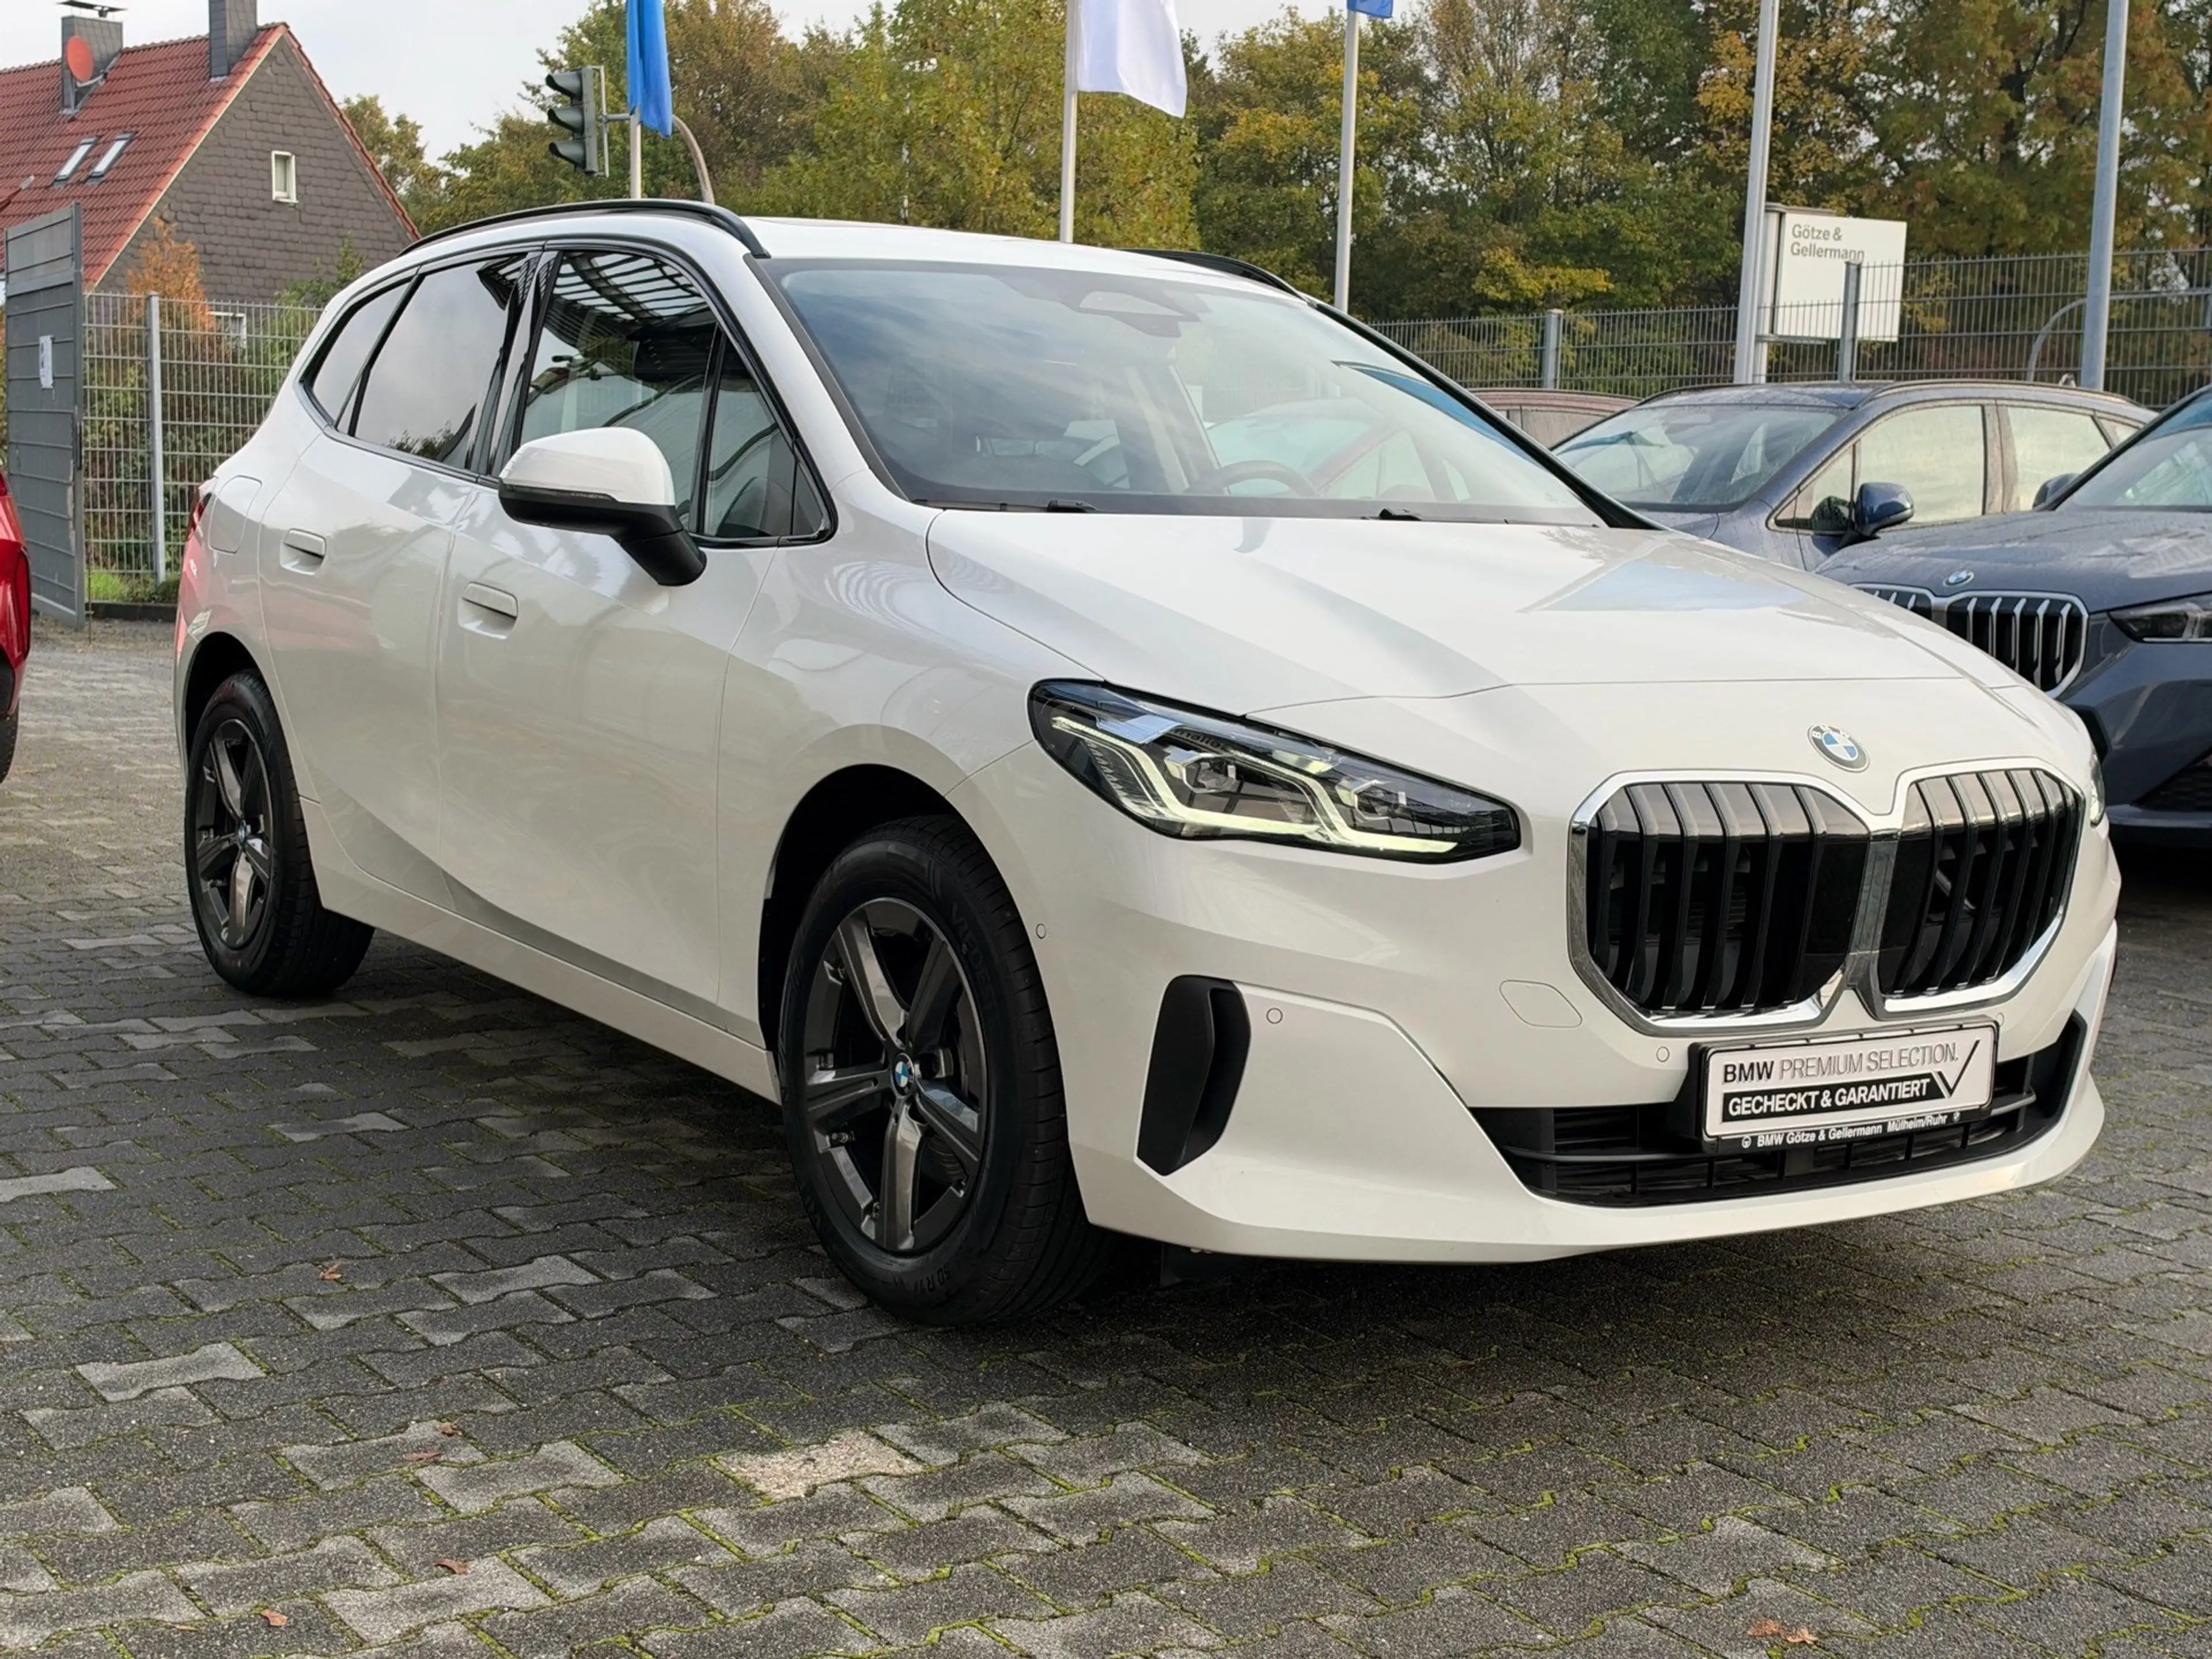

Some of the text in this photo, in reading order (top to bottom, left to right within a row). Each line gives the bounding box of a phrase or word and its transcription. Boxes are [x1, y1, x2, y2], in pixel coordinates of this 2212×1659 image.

[1791, 224, 1842, 241] Götze &
[1790, 243, 1865, 262] Gellermann
[1724, 1060, 1774, 1083] BMW
[1779, 1052, 1863, 1080] PREMIUM
[1729, 1078, 1930, 1116] GECHECKT & GARANTIERT
[1757, 1114, 1948, 1147] BMW Götze & Gellermann Mülheim/Ruhr
